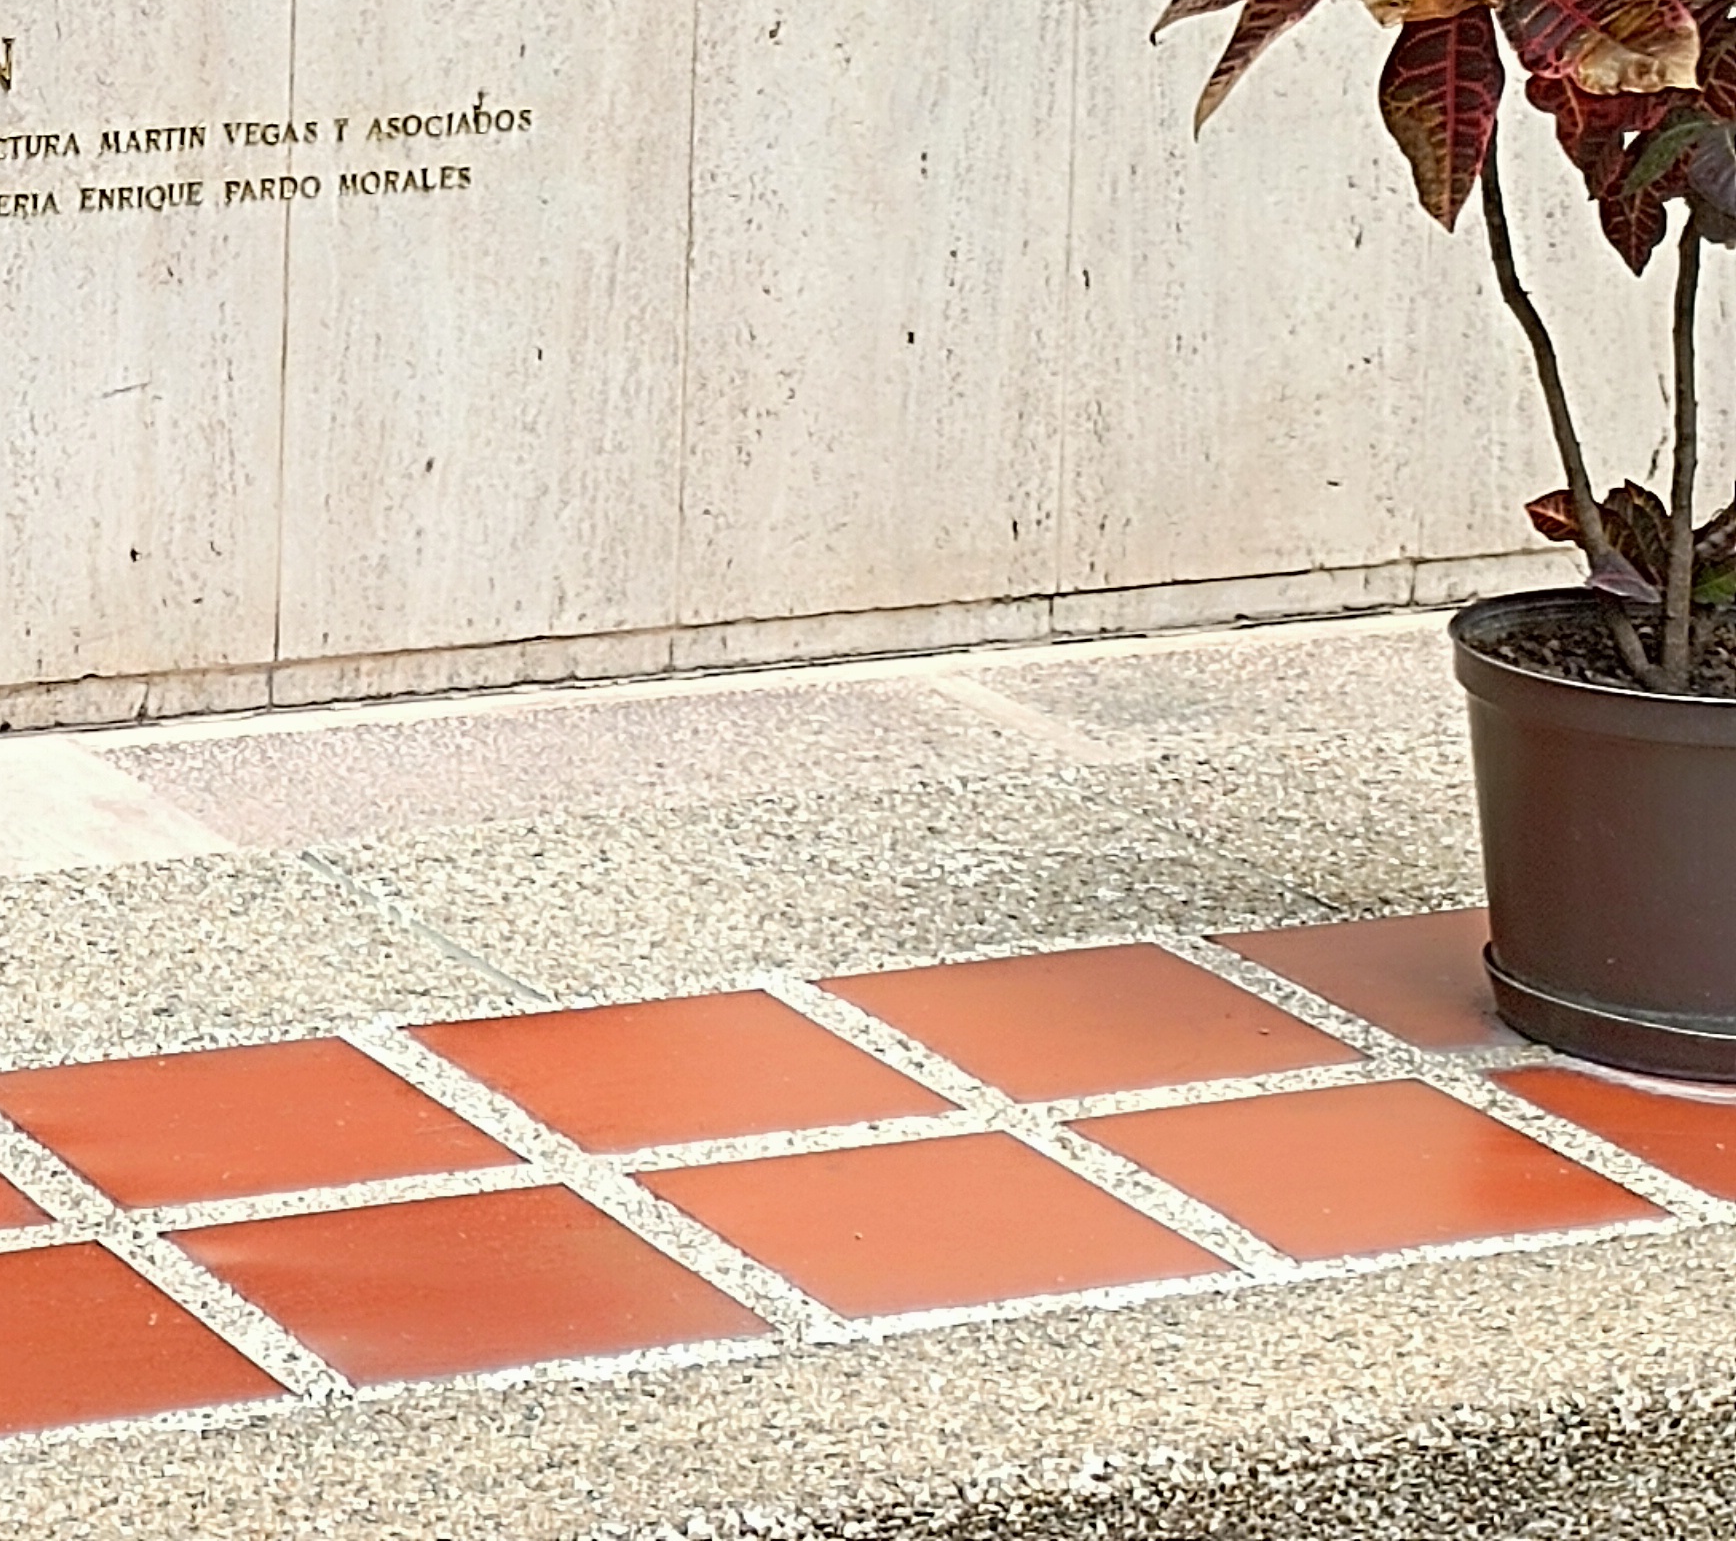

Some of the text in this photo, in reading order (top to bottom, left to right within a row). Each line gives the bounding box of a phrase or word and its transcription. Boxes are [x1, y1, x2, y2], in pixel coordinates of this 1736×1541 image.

[100, 124, 207, 156] MARTIN
[224, 120, 319, 147] VEGAS
[334, 117, 346, 142] Y
[365, 107, 532, 140] ASOCIADOS
[78, 180, 204, 212] ENRIQUE
[223, 174, 321, 204] PARDO
[339, 165, 472, 195] MORALES
